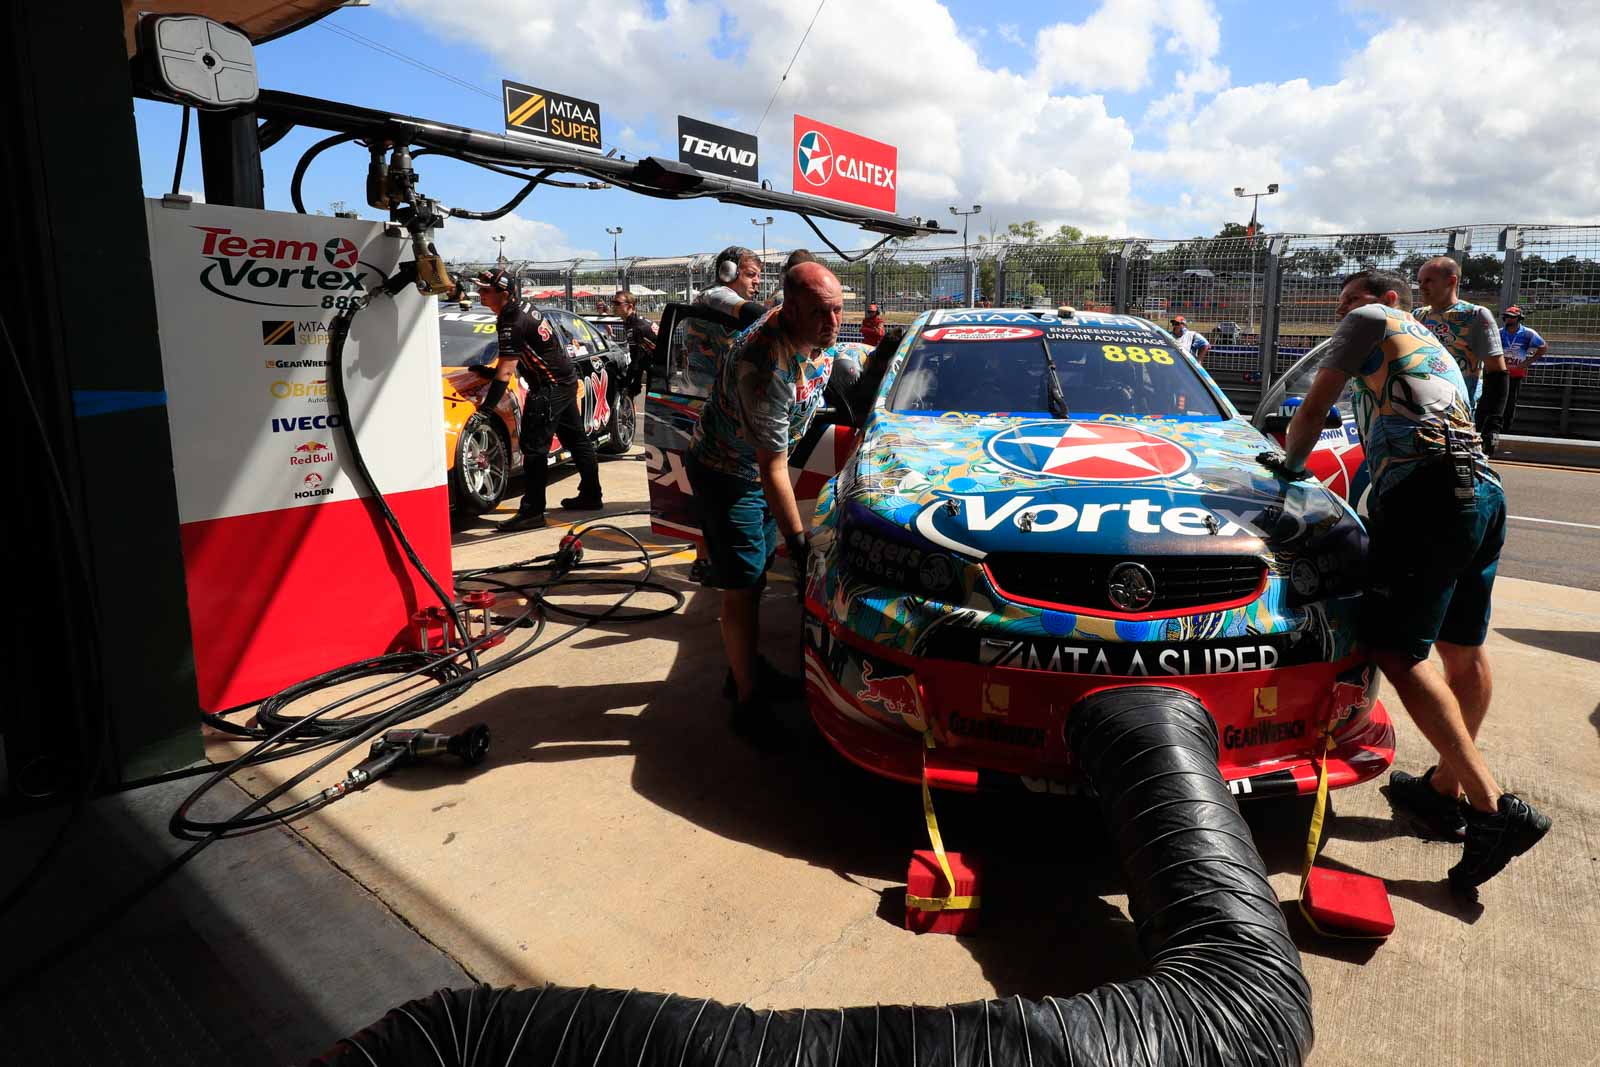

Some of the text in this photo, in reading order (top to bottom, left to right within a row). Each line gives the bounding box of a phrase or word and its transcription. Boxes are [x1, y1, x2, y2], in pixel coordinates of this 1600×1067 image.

[549, 98, 597, 125] MTAA
[551, 118, 600, 144] SUPER
[681, 134, 757, 167] TEKNO
[836, 154, 895, 190] CALTEX
[189, 225, 318, 261] Team
[203, 256, 368, 291] Vortex
[942, 314, 1038, 323] MTAA
[473, 323, 497, 334] 19
[1049, 327, 1154, 338] ENGINEERING THE
[299, 333, 331, 345] SUPE
[1046, 333, 1168, 346] UNFAIR ADVANTAGE
[1102, 344, 1175, 365] 888
[272, 414, 342, 432] IVECO
[1319, 429, 1343, 440] RWIN
[290, 452, 333, 465] Red Bull
[294, 488, 334, 499] HOLDEN
[964, 496, 1269, 538] Vortex
[1159, 645, 1279, 676] SUPER
